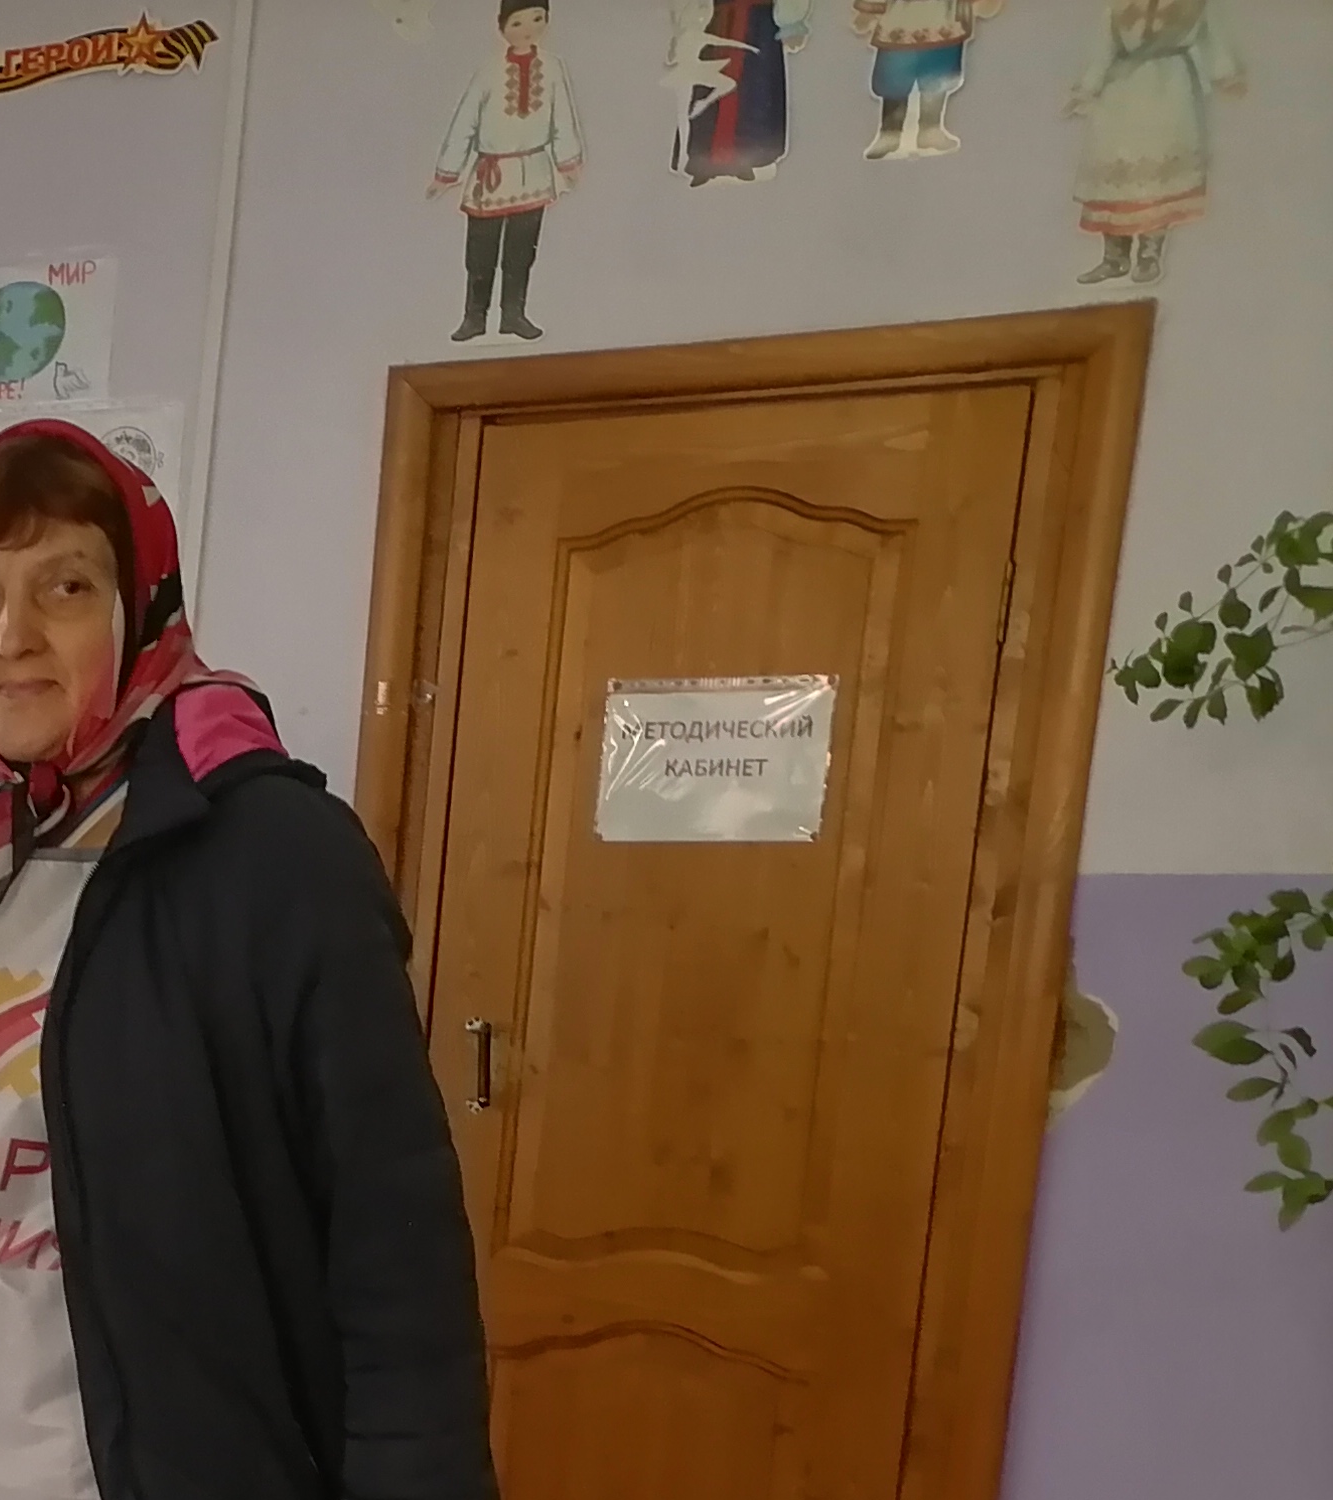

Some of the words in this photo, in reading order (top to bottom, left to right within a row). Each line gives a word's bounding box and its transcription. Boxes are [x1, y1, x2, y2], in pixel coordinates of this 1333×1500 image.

[4, 32, 116, 78] ГЕРОИ
[48, 260, 97, 286] МИР
[664, 758, 768, 778] КАБИНЕТ
